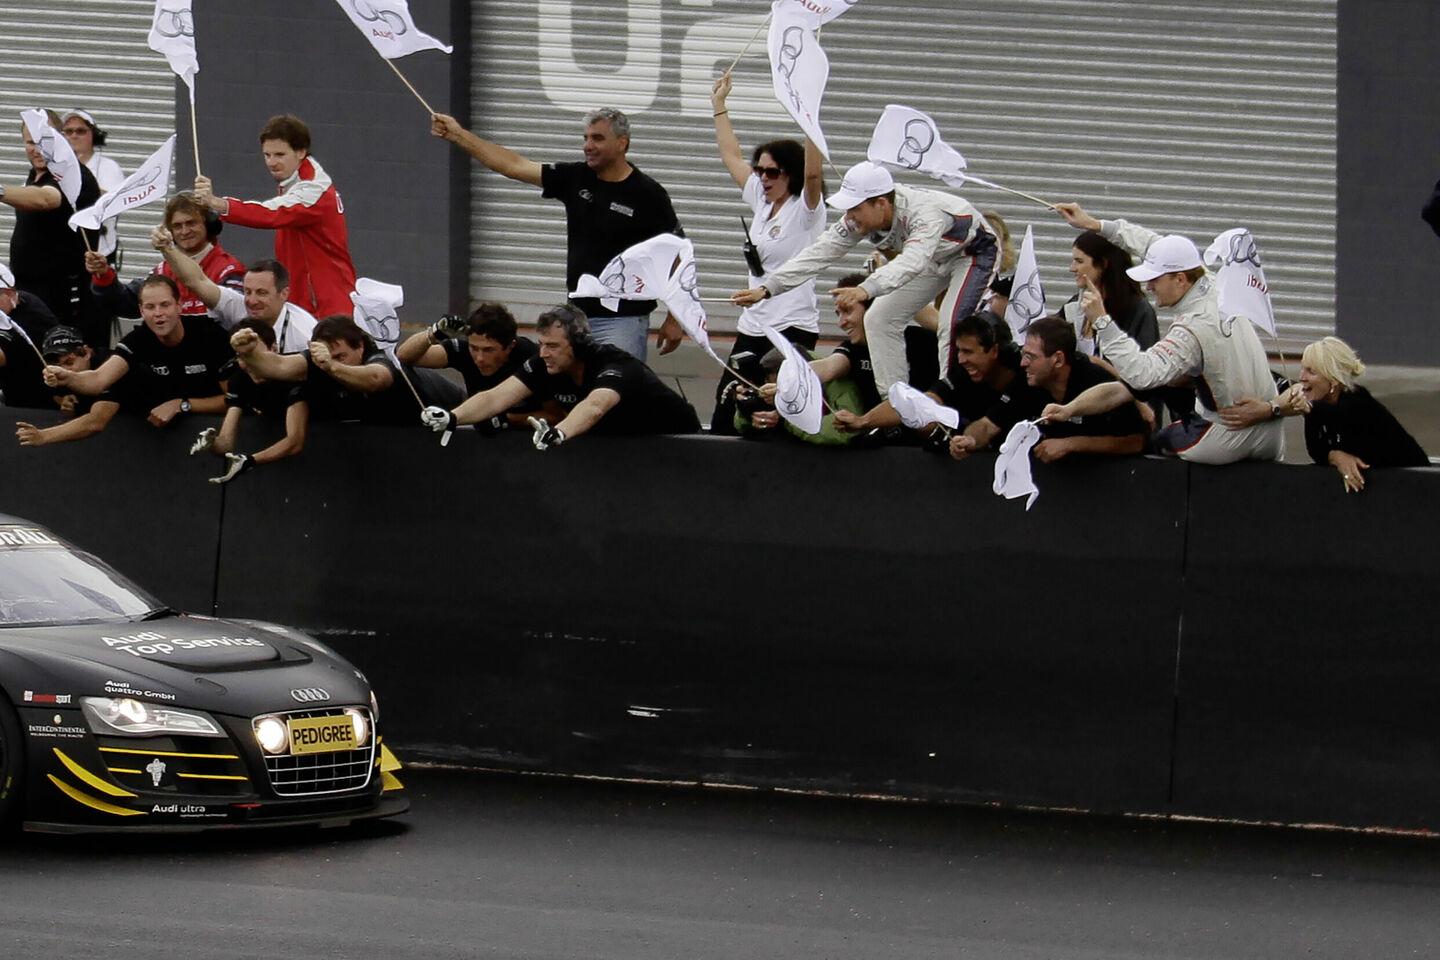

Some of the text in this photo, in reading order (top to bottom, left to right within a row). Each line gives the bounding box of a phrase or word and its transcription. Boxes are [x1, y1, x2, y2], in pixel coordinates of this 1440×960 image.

[101, 631, 167, 647] Audi
[115, 635, 265, 657] Top Service
[104, 679, 130, 689] Audi
[104, 686, 176, 701] quattro GmbH
[292, 724, 353, 746] PEDIGREE
[151, 804, 206, 813] Audi ultra
